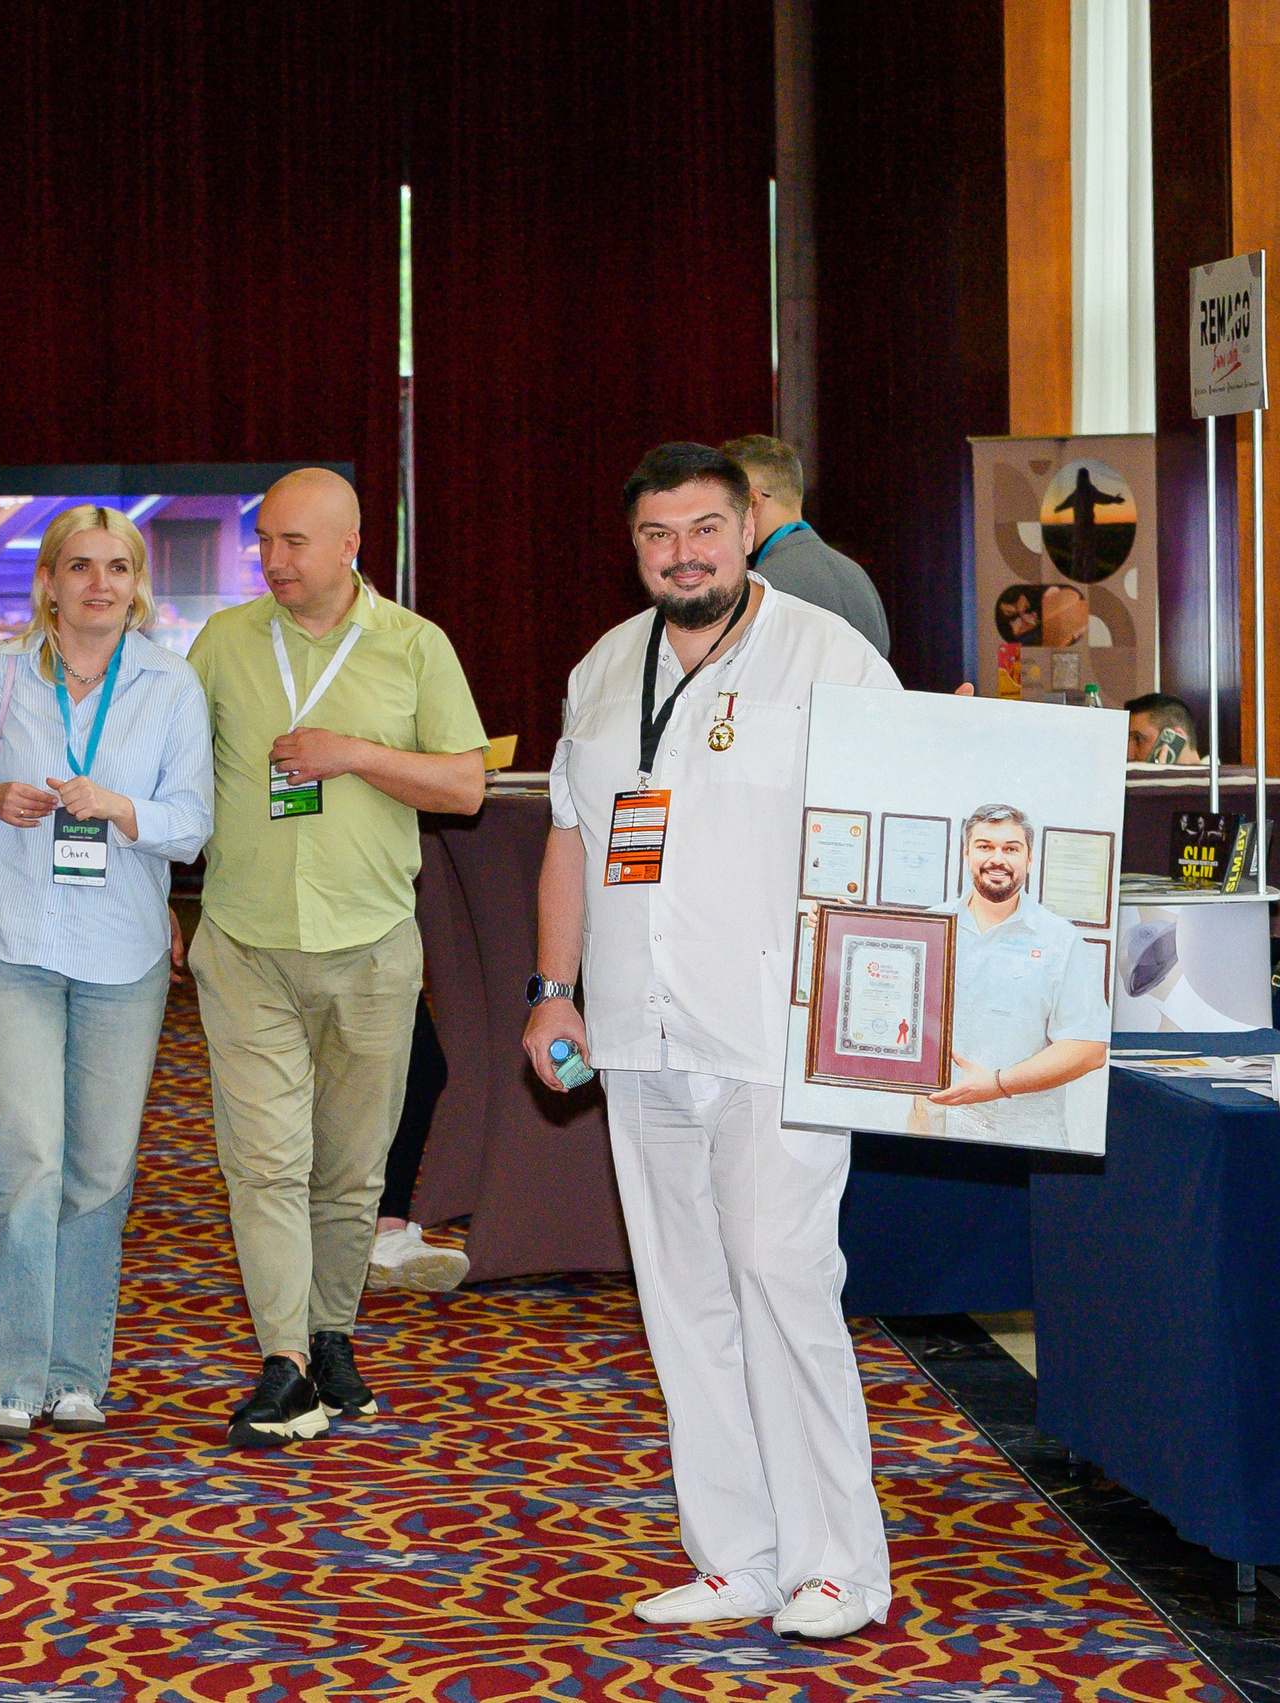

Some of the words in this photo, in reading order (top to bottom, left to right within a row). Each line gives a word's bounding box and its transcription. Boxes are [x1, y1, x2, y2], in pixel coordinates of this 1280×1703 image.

[63, 825, 100, 834] ПАРТНЕР
[1182, 846, 1215, 878] SLM
[1225, 828, 1247, 893] SLM.BY
